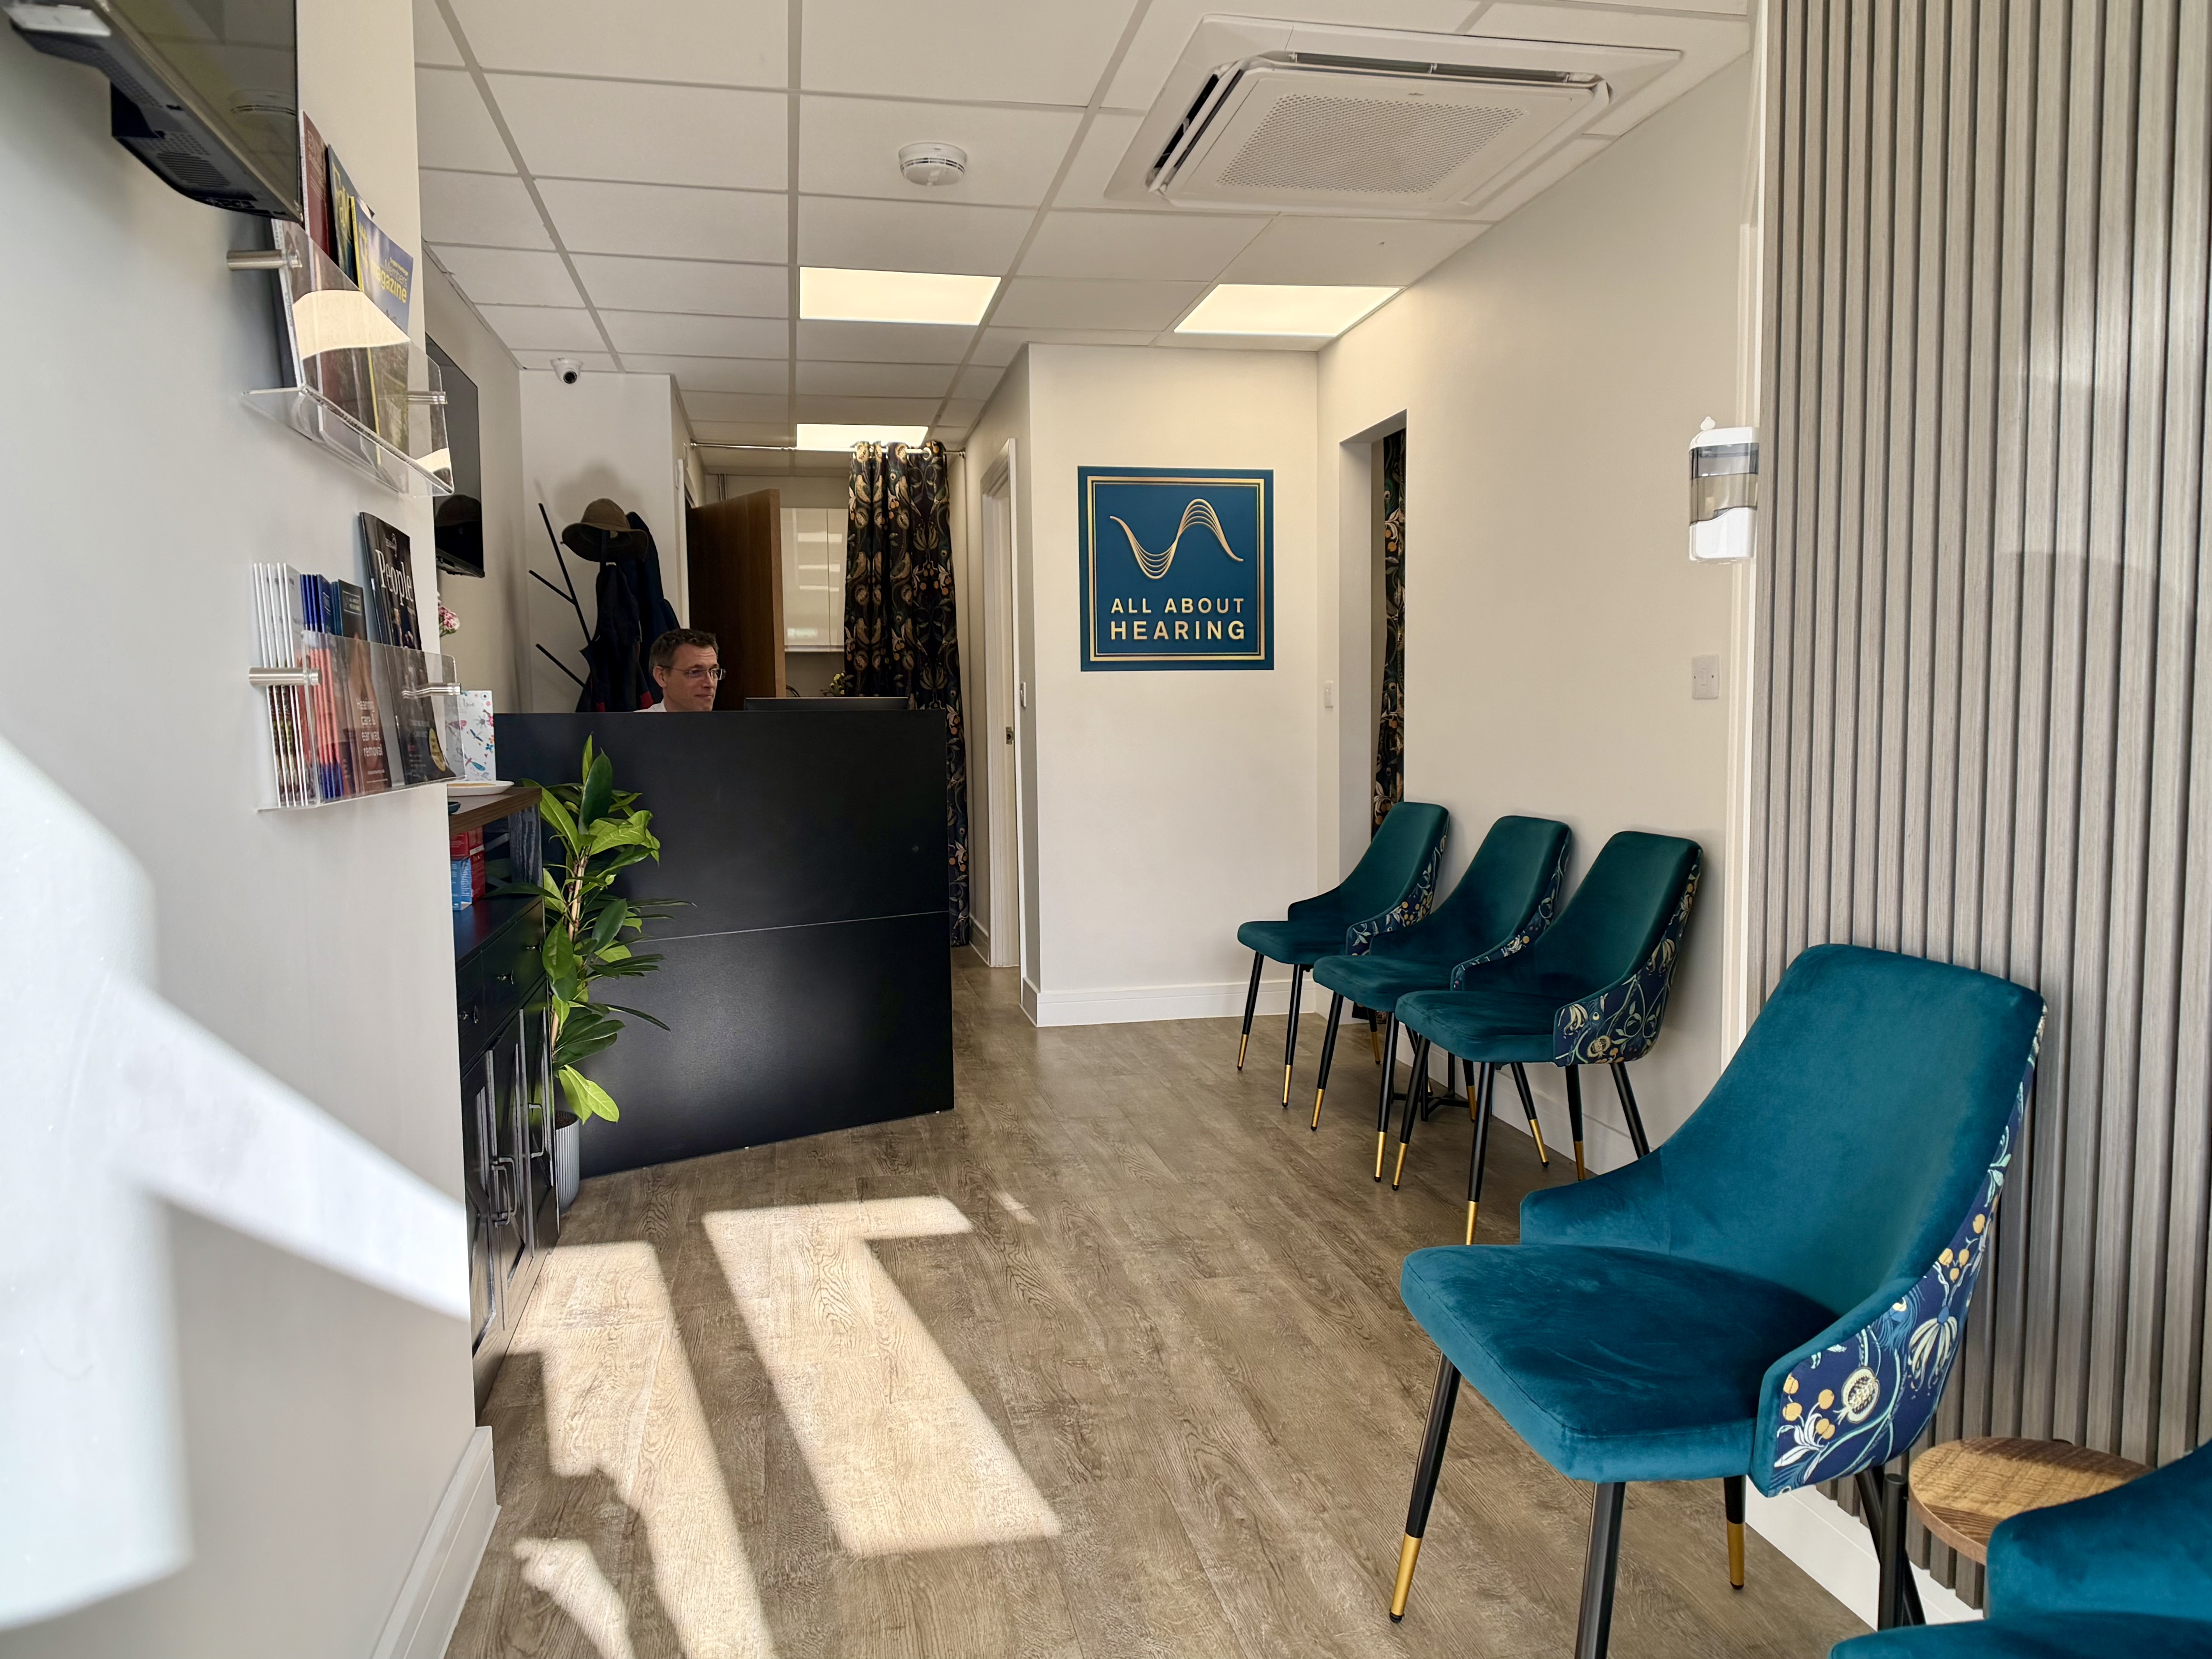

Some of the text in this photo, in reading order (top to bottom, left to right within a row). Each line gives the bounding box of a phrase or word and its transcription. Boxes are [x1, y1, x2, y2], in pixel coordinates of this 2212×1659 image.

[371, 259, 407, 304] magazine
[375, 549, 414, 606] People
[1111, 597, 1245, 614] ALL ABOUT
[1111, 620, 1245, 640] HEARING
[357, 698, 375, 713] Hearing
[361, 716, 372, 726] care
[362, 731, 370, 742] ear
[363, 743, 383, 757] removal
